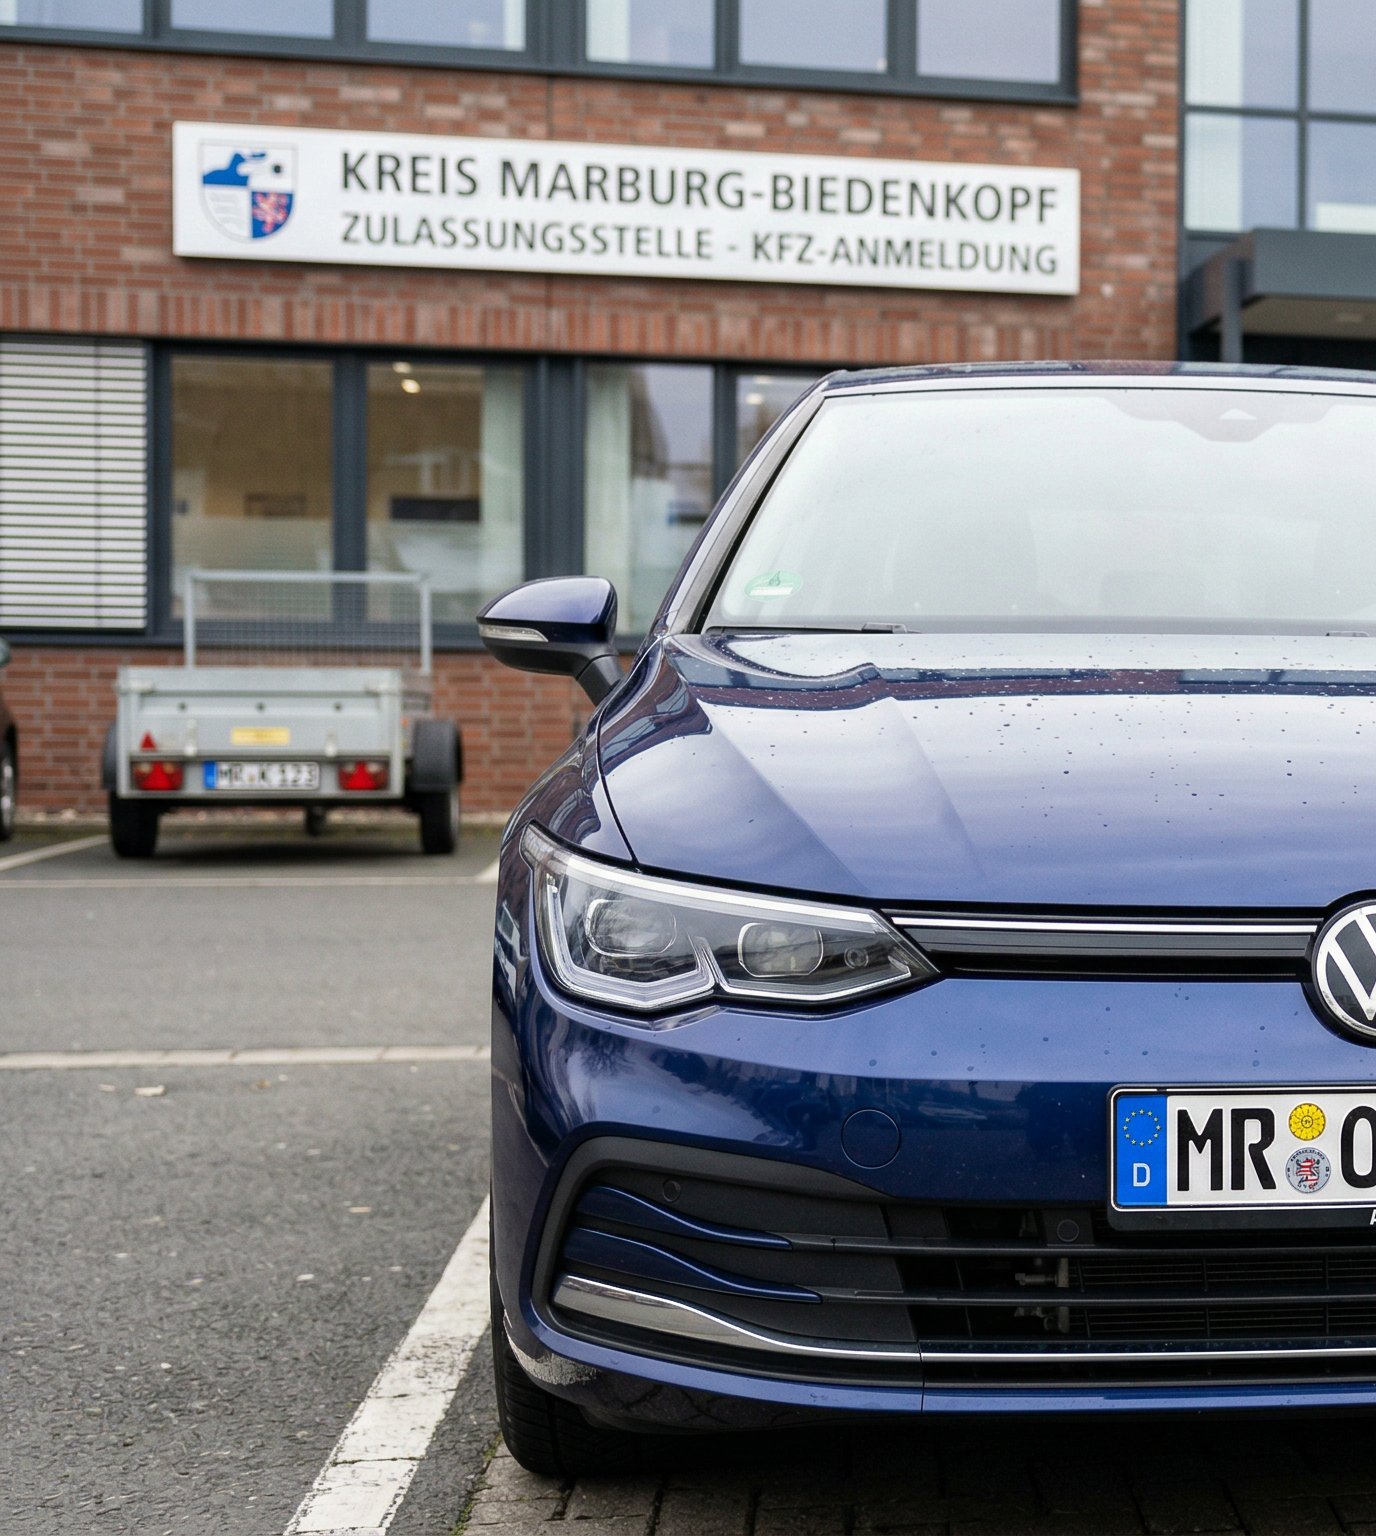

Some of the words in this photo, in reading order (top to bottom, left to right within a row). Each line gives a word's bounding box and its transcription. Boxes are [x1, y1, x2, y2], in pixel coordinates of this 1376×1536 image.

[342, 151, 478, 197] KREIS
[499, 159, 1057, 224] MARBURG-BIEDENKOPF
[341, 212, 713, 260] ZULASSUNGSSTELLE
[751, 233, 1058, 276] KFZ-ANMELDUNG
[1133, 1162, 1151, 1187] D
[1177, 1108, 1276, 1192] MR
